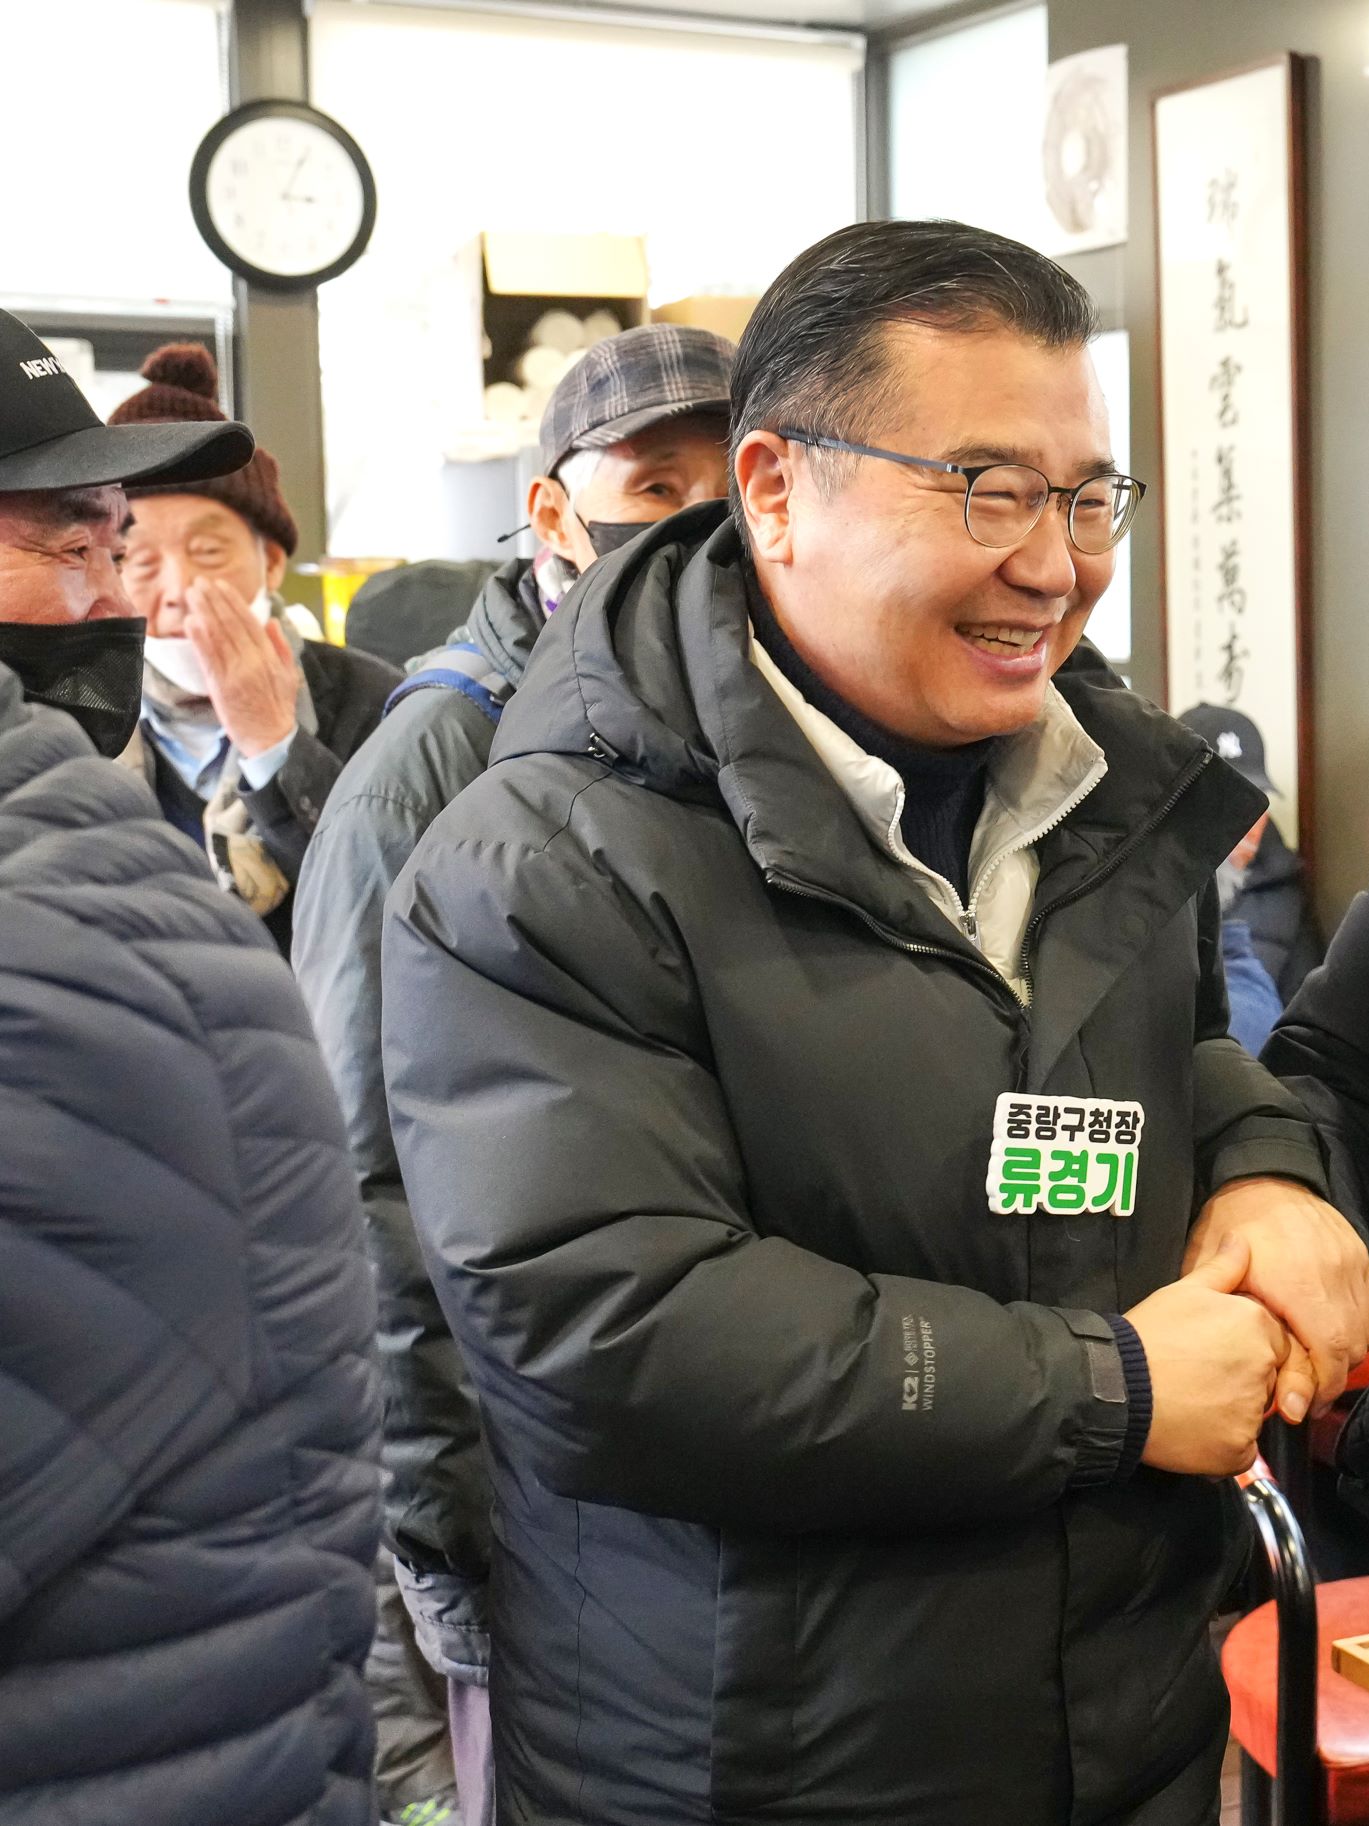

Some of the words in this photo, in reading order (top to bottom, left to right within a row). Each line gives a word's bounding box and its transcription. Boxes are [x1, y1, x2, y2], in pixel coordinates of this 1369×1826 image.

[1006, 1102, 1141, 1145] 중랑구청장
[998, 1146, 1135, 1211] 류경기
[920, 1319, 936, 1411] WINDSTOPPER
[901, 1376, 919, 1411] K2
